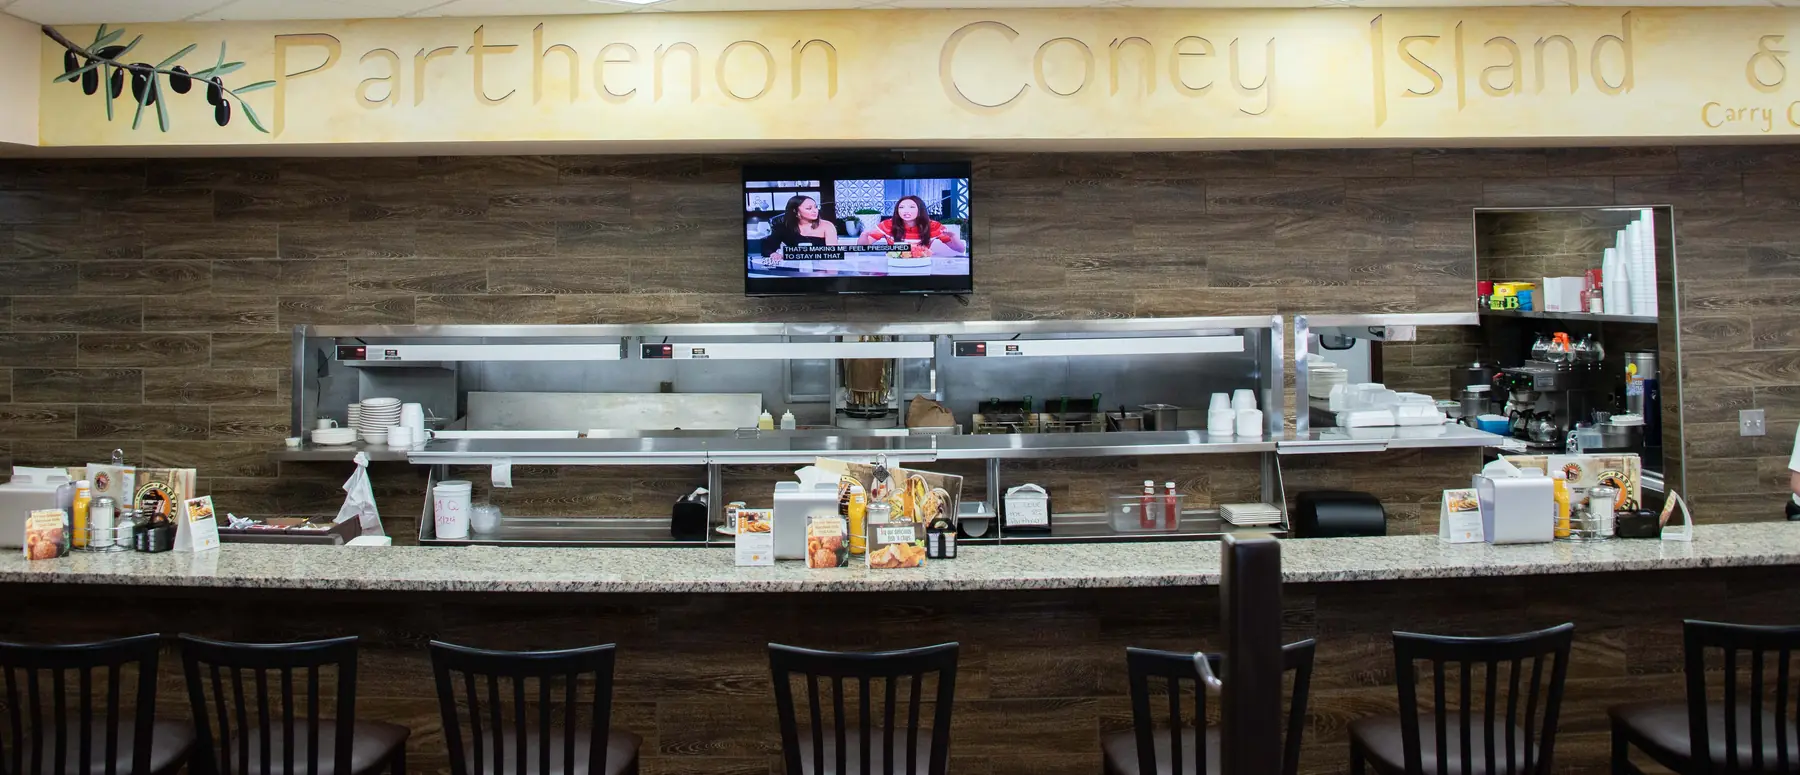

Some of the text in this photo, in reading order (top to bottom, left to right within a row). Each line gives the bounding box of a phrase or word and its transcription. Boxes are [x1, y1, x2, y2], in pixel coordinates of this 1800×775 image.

[272, 10, 1791, 138] Parthenon Coney Island &
[1701, 101, 1773, 133] Carry
[808, 245, 836, 253] MAKING
[867, 244, 909, 252] PRESSURED
